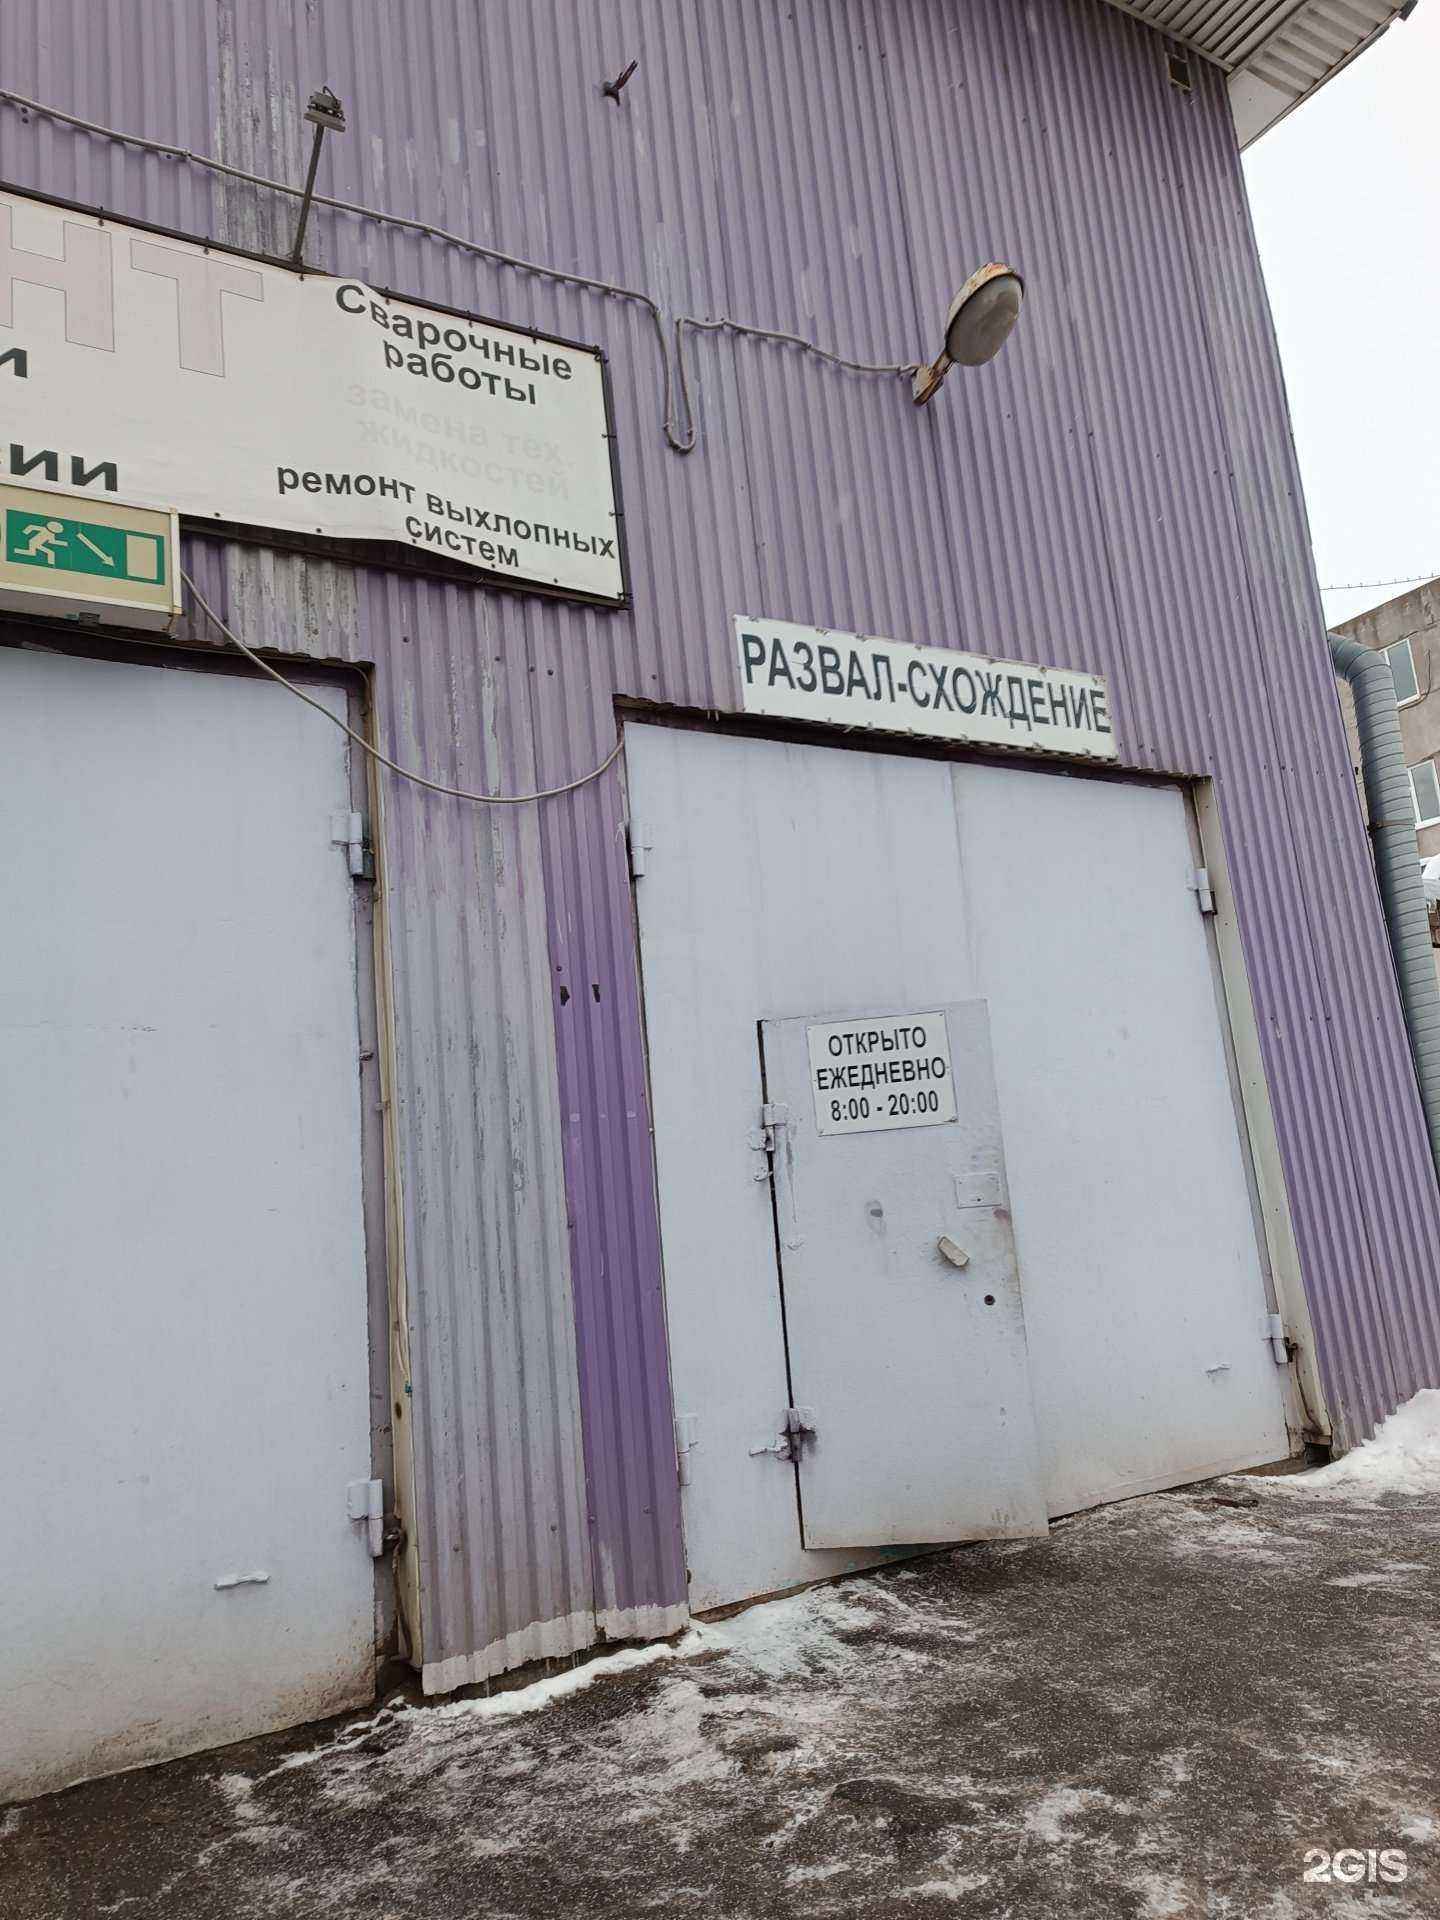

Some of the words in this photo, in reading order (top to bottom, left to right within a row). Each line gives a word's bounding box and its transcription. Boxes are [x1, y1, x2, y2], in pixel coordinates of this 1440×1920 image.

[335, 284, 573, 381] Сварочные
[383, 339, 537, 406] работы
[347, 383, 489, 449] замена
[357, 420, 569, 501] жидкостей
[277, 466, 416, 503] ремонт
[425, 492, 617, 560] выхлопных
[405, 515, 520, 568] систем
[741, 633, 1112, 734] РАЗВАЛ-СХОЖДЕНИЕ
[816, 1056, 946, 1090] ЕЖЕДНЕВНО
[828, 1026, 927, 1057] ОТКРЫТО
[830, 1096, 870, 1122] 8:00
[887, 1090, 939, 1116] 20:00
